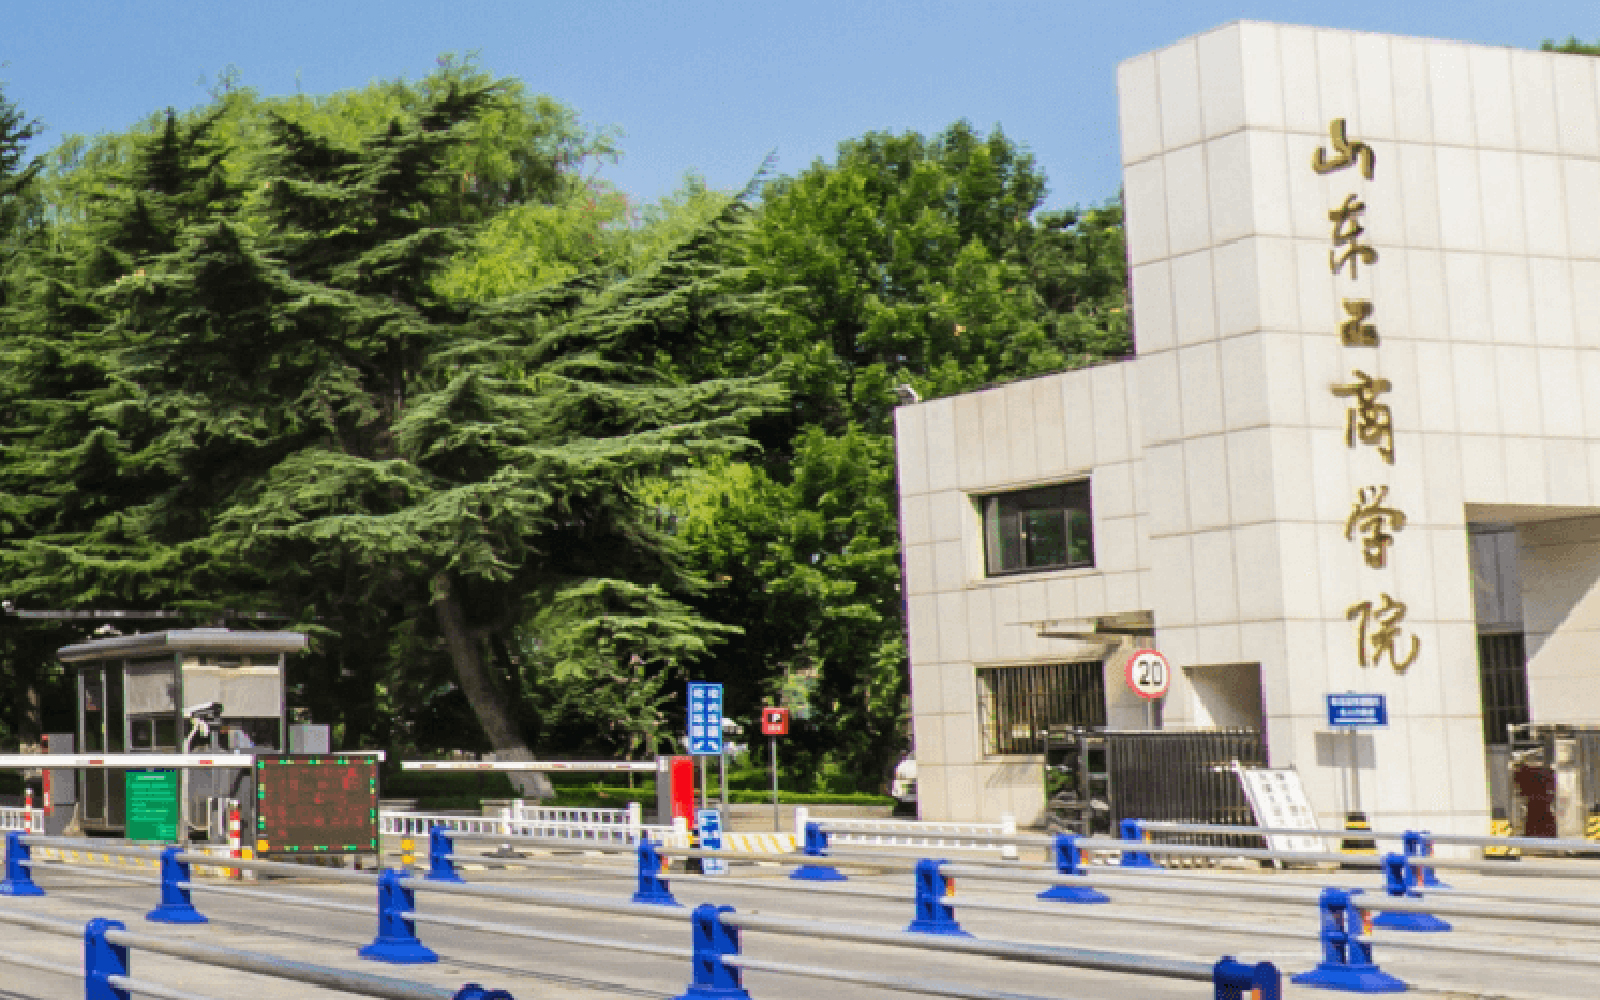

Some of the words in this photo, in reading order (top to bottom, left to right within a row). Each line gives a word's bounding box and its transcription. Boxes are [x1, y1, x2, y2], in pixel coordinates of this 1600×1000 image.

[1312, 117, 1420, 676] 山东工商学院
[1138, 660, 1162, 686] 20
